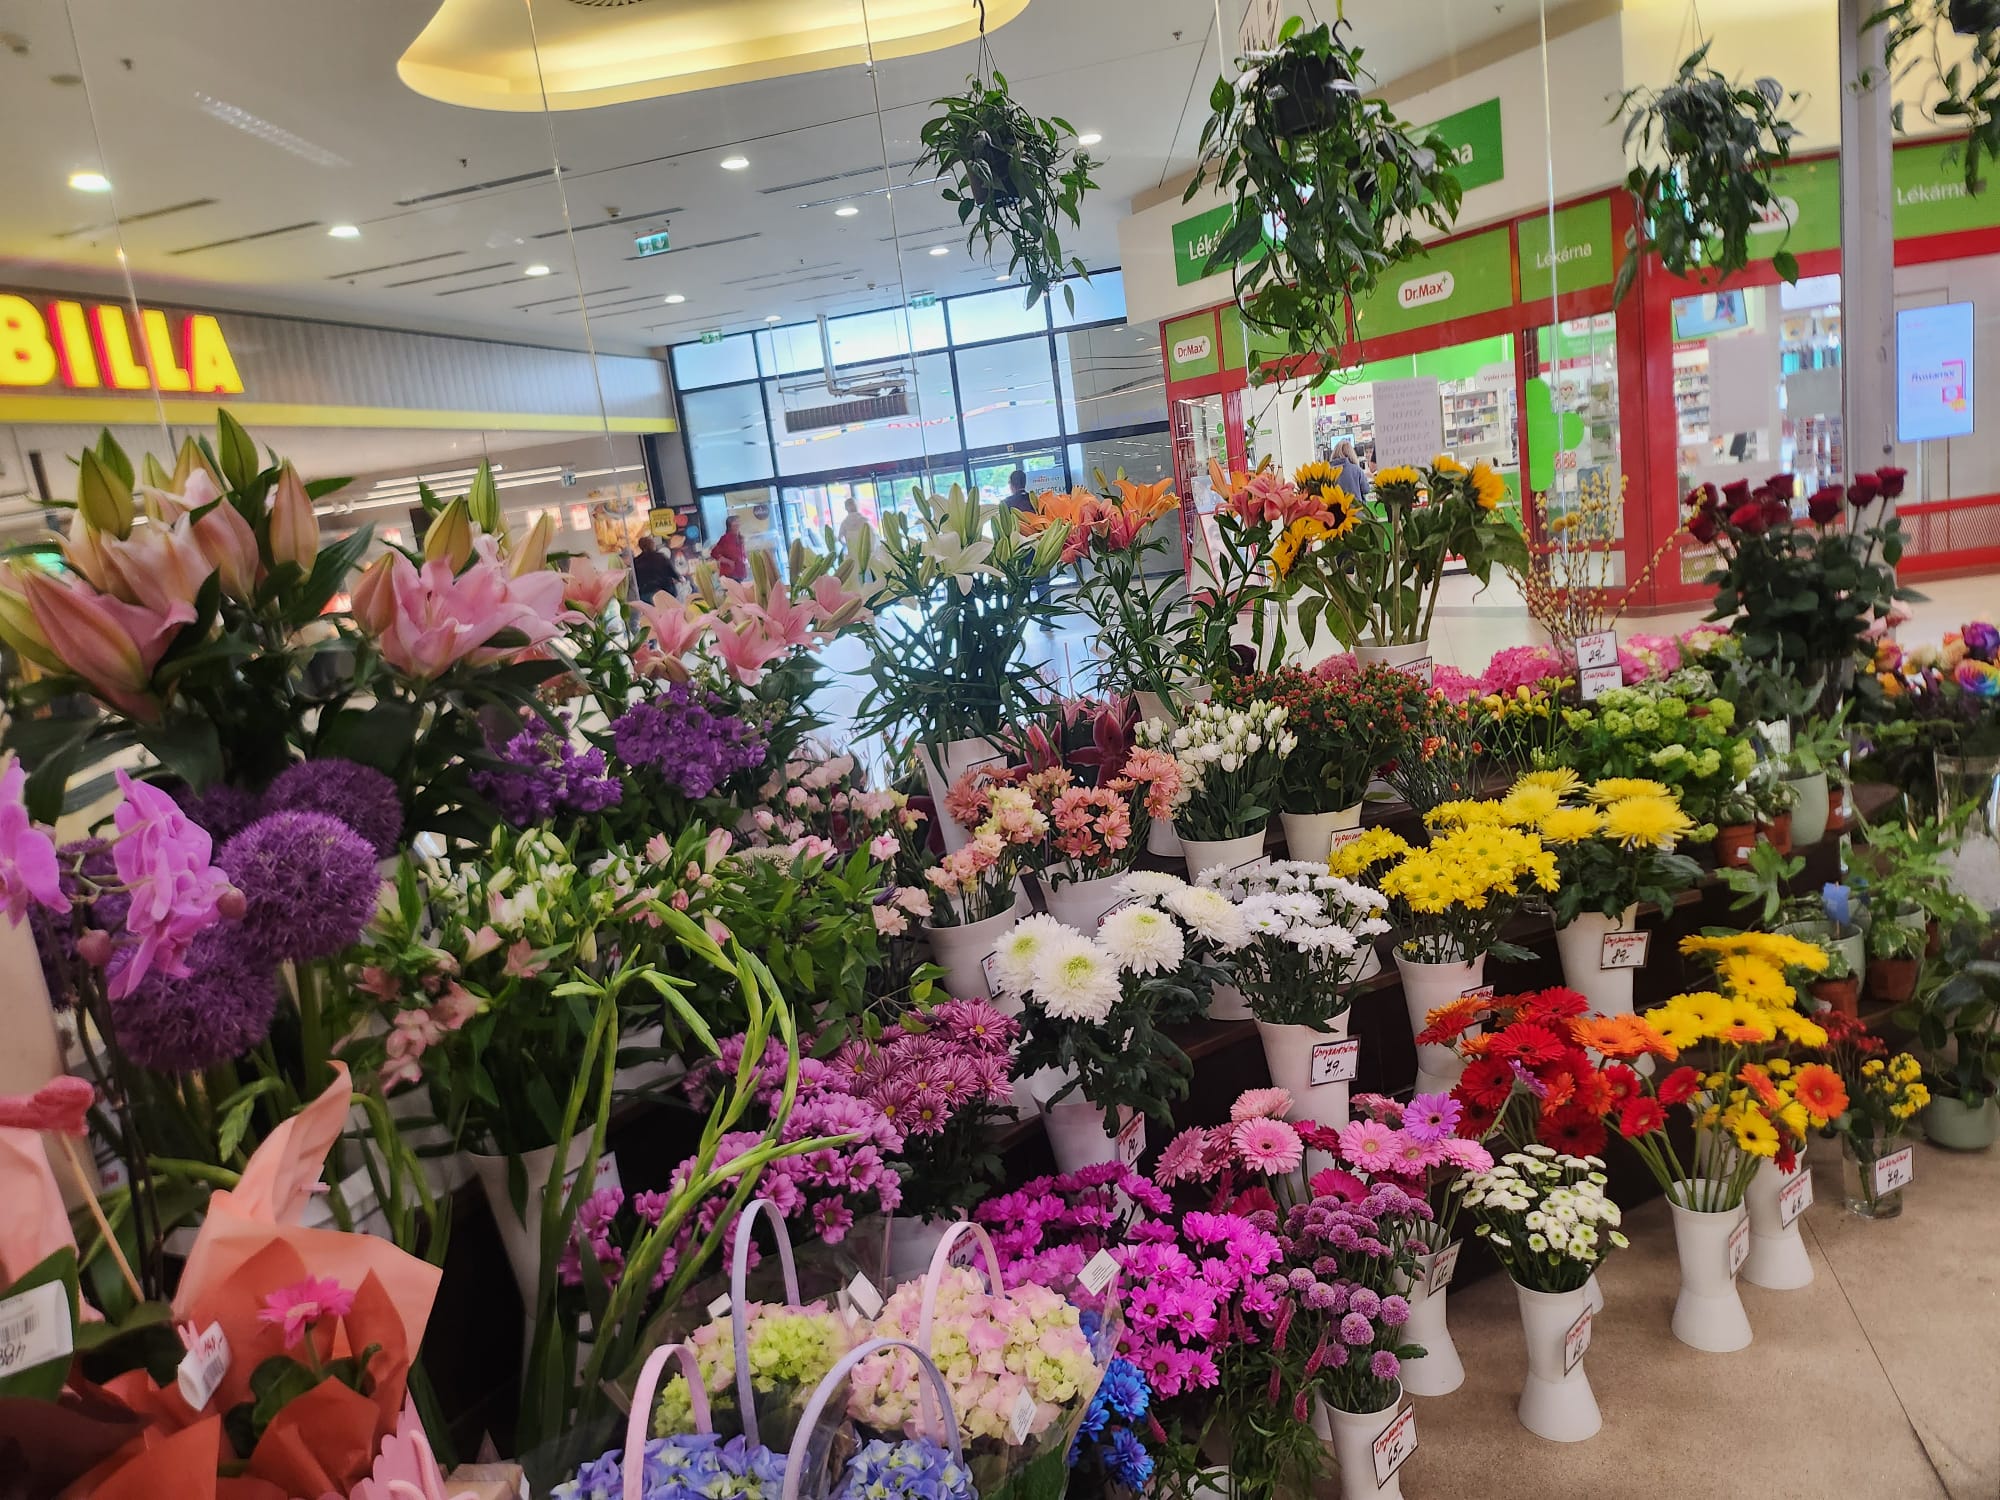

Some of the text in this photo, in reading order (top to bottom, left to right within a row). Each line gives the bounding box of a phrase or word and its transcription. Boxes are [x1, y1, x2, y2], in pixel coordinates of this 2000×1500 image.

[1404, 281, 1443, 302] Dr.Max
[0, 294, 245, 393] BILLA
[1177, 344, 1204, 358] Dr.Max
